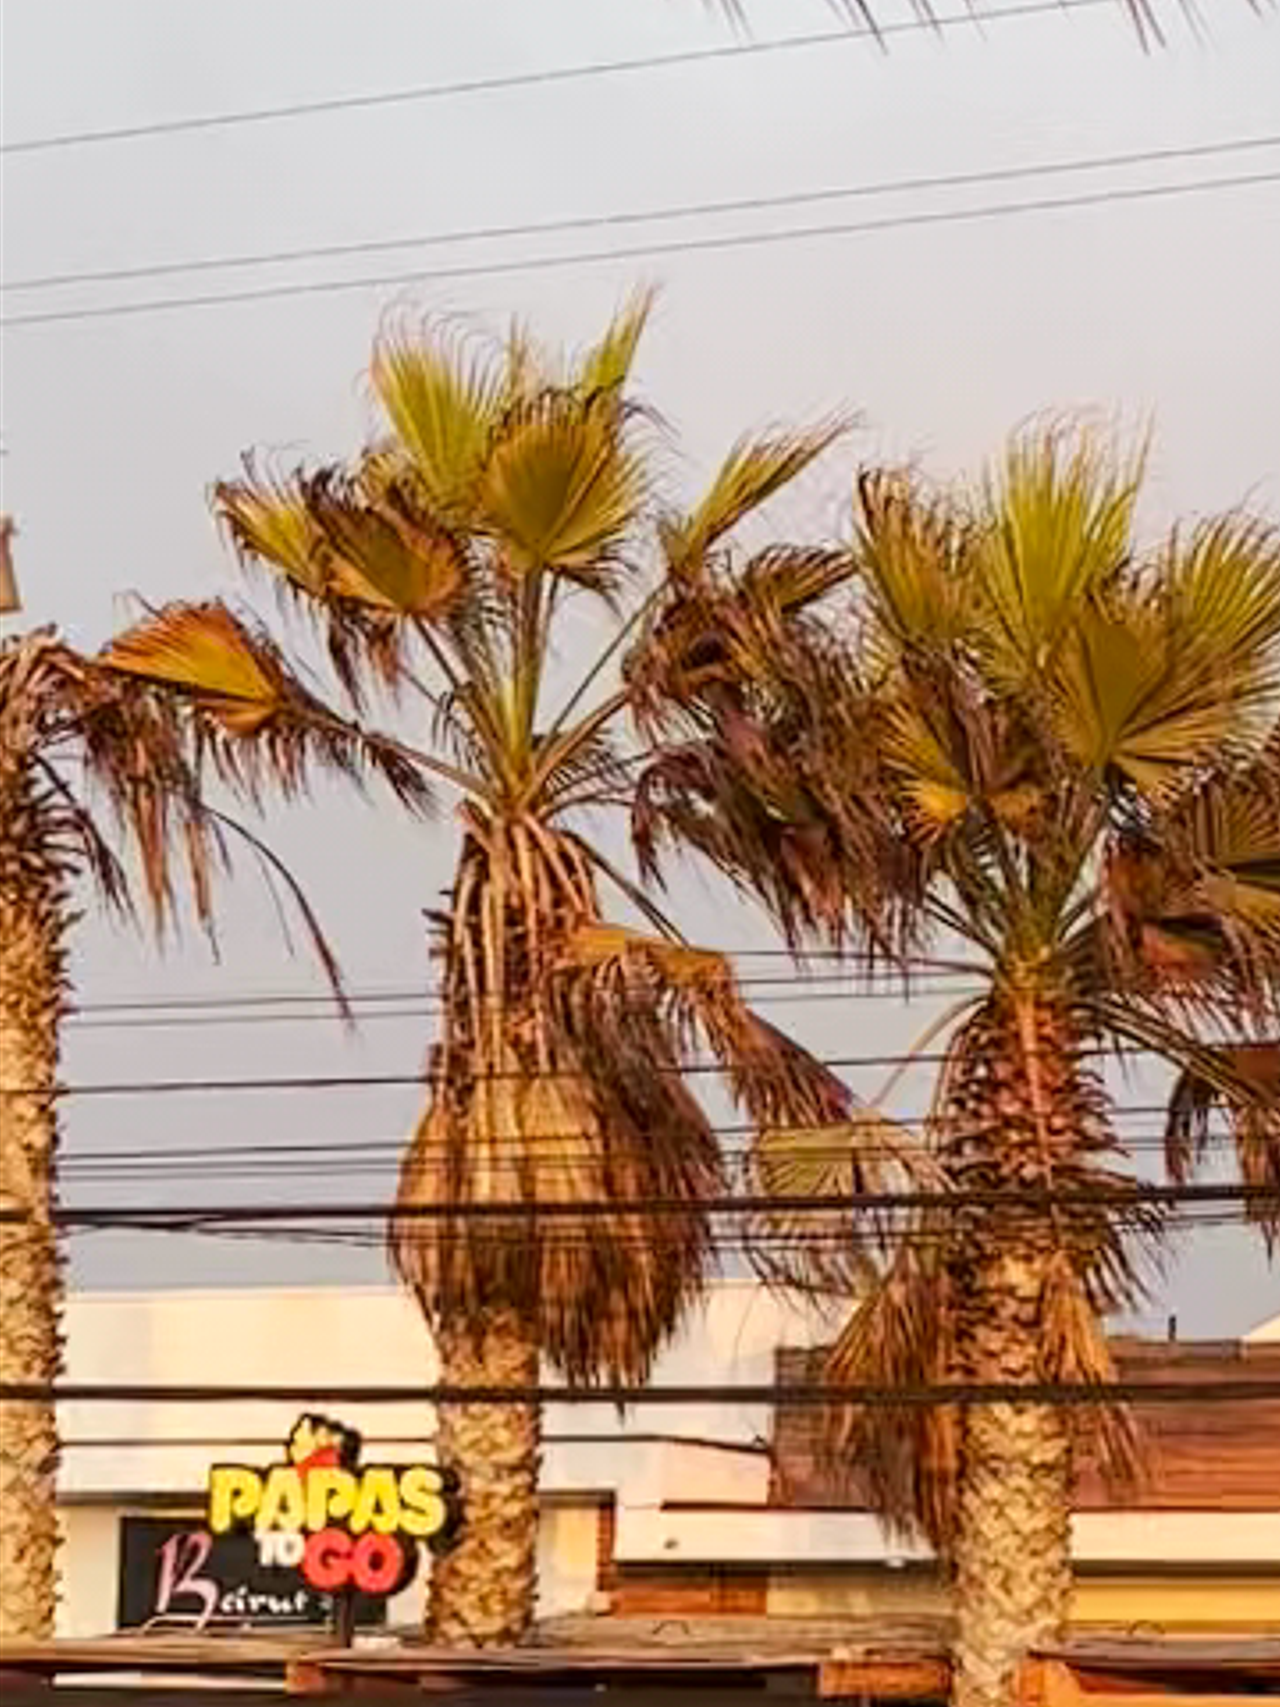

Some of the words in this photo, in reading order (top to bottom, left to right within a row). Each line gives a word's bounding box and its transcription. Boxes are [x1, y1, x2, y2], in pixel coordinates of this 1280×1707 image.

[209, 1466, 447, 1535] PAPAS
[156, 1532, 307, 1631] Beirut
[255, 1530, 305, 1566] TO
[303, 1528, 401, 1593] GO
